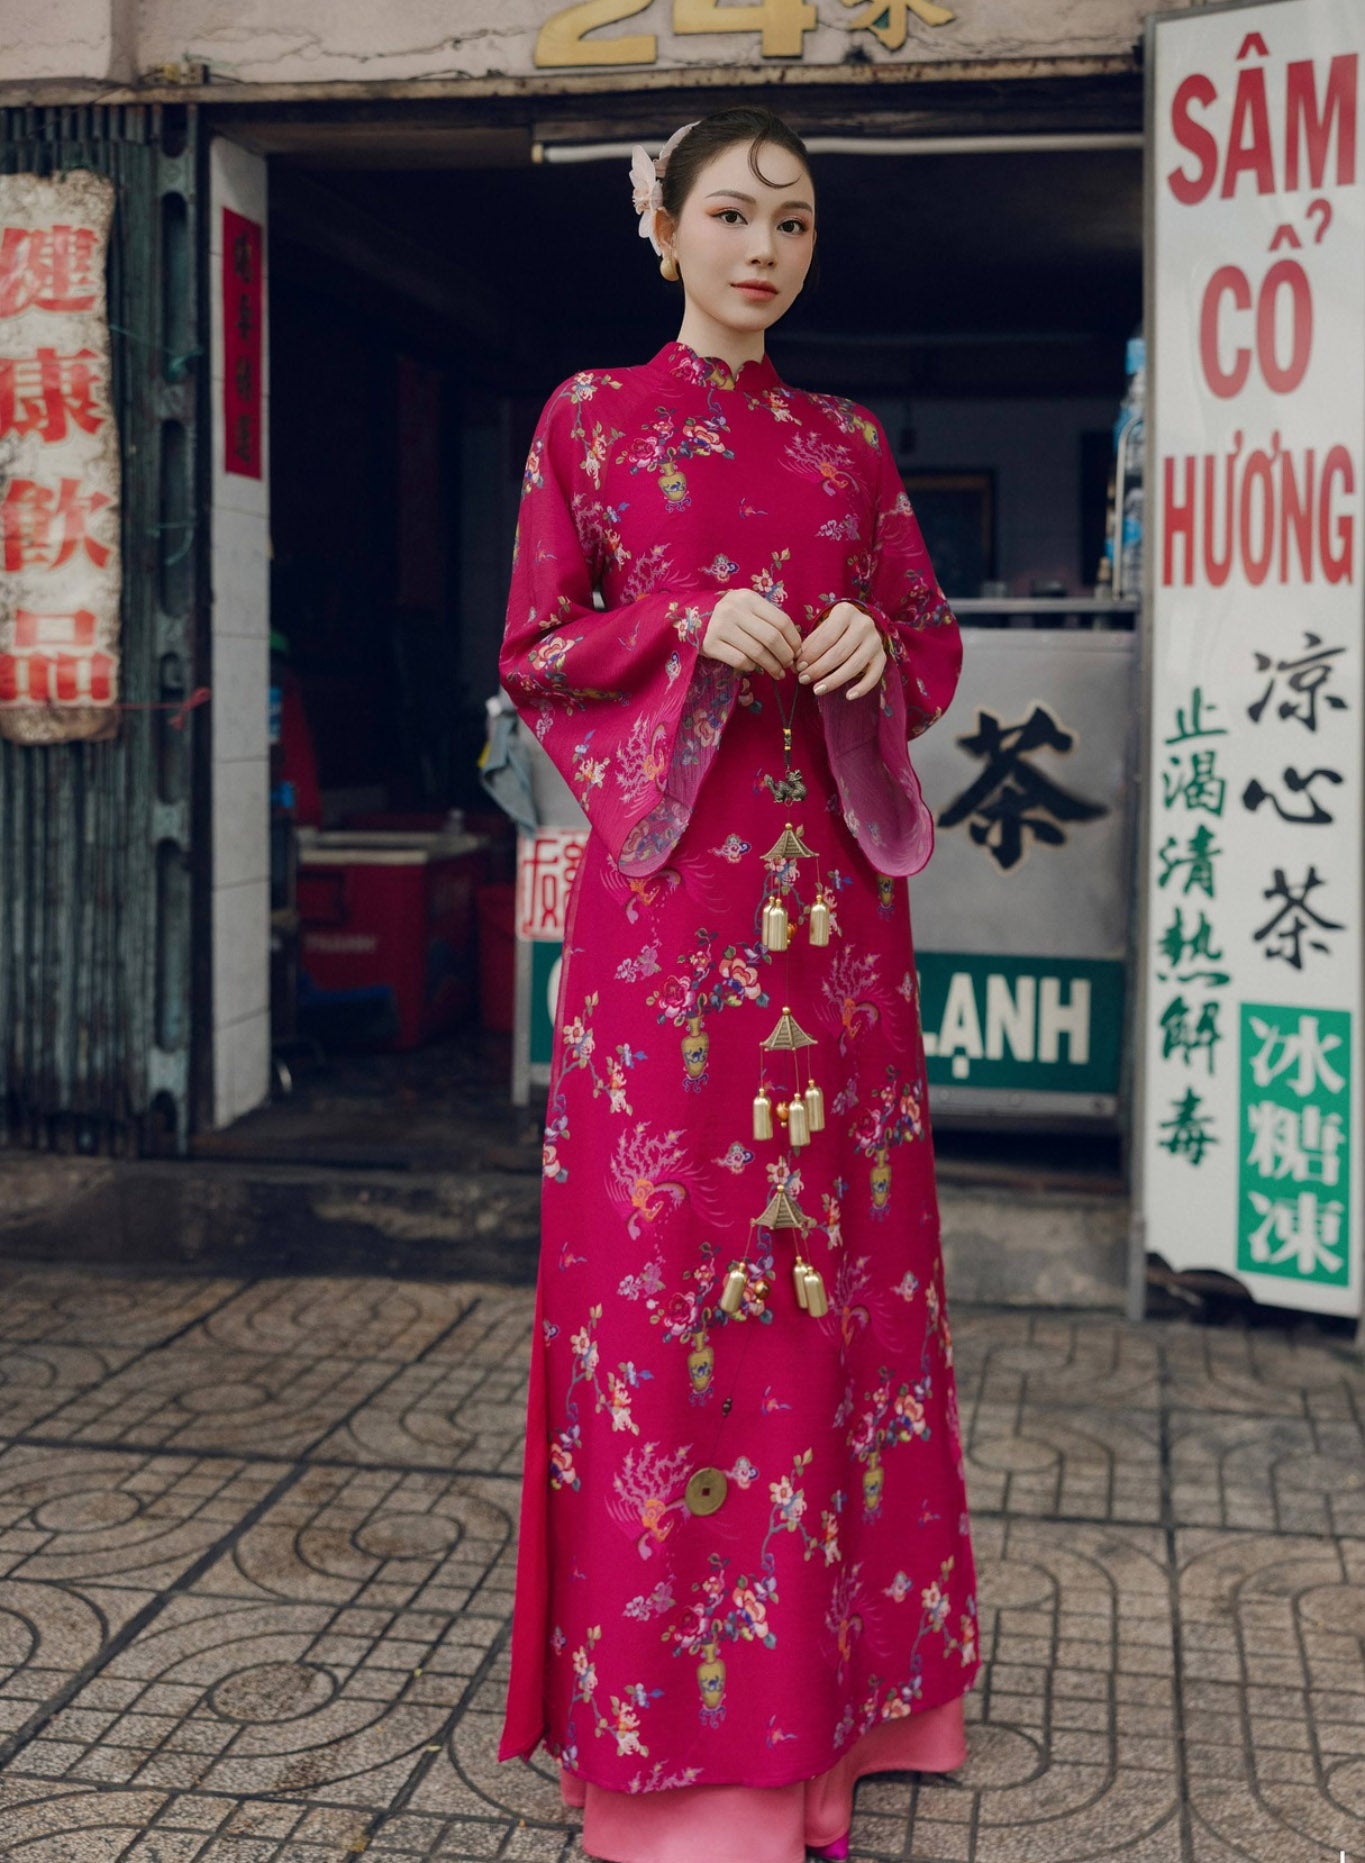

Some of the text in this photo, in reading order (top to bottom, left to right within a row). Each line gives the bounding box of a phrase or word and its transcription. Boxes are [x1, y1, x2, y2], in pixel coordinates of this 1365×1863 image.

[1167, 32, 1358, 206] SÂM
[1200, 198, 1333, 399] CỔ
[1163, 430, 1355, 588] HƯƠNG
[938, 705, 1108, 871] 茶
[1247, 1014, 1346, 1275] 冰糖凍
